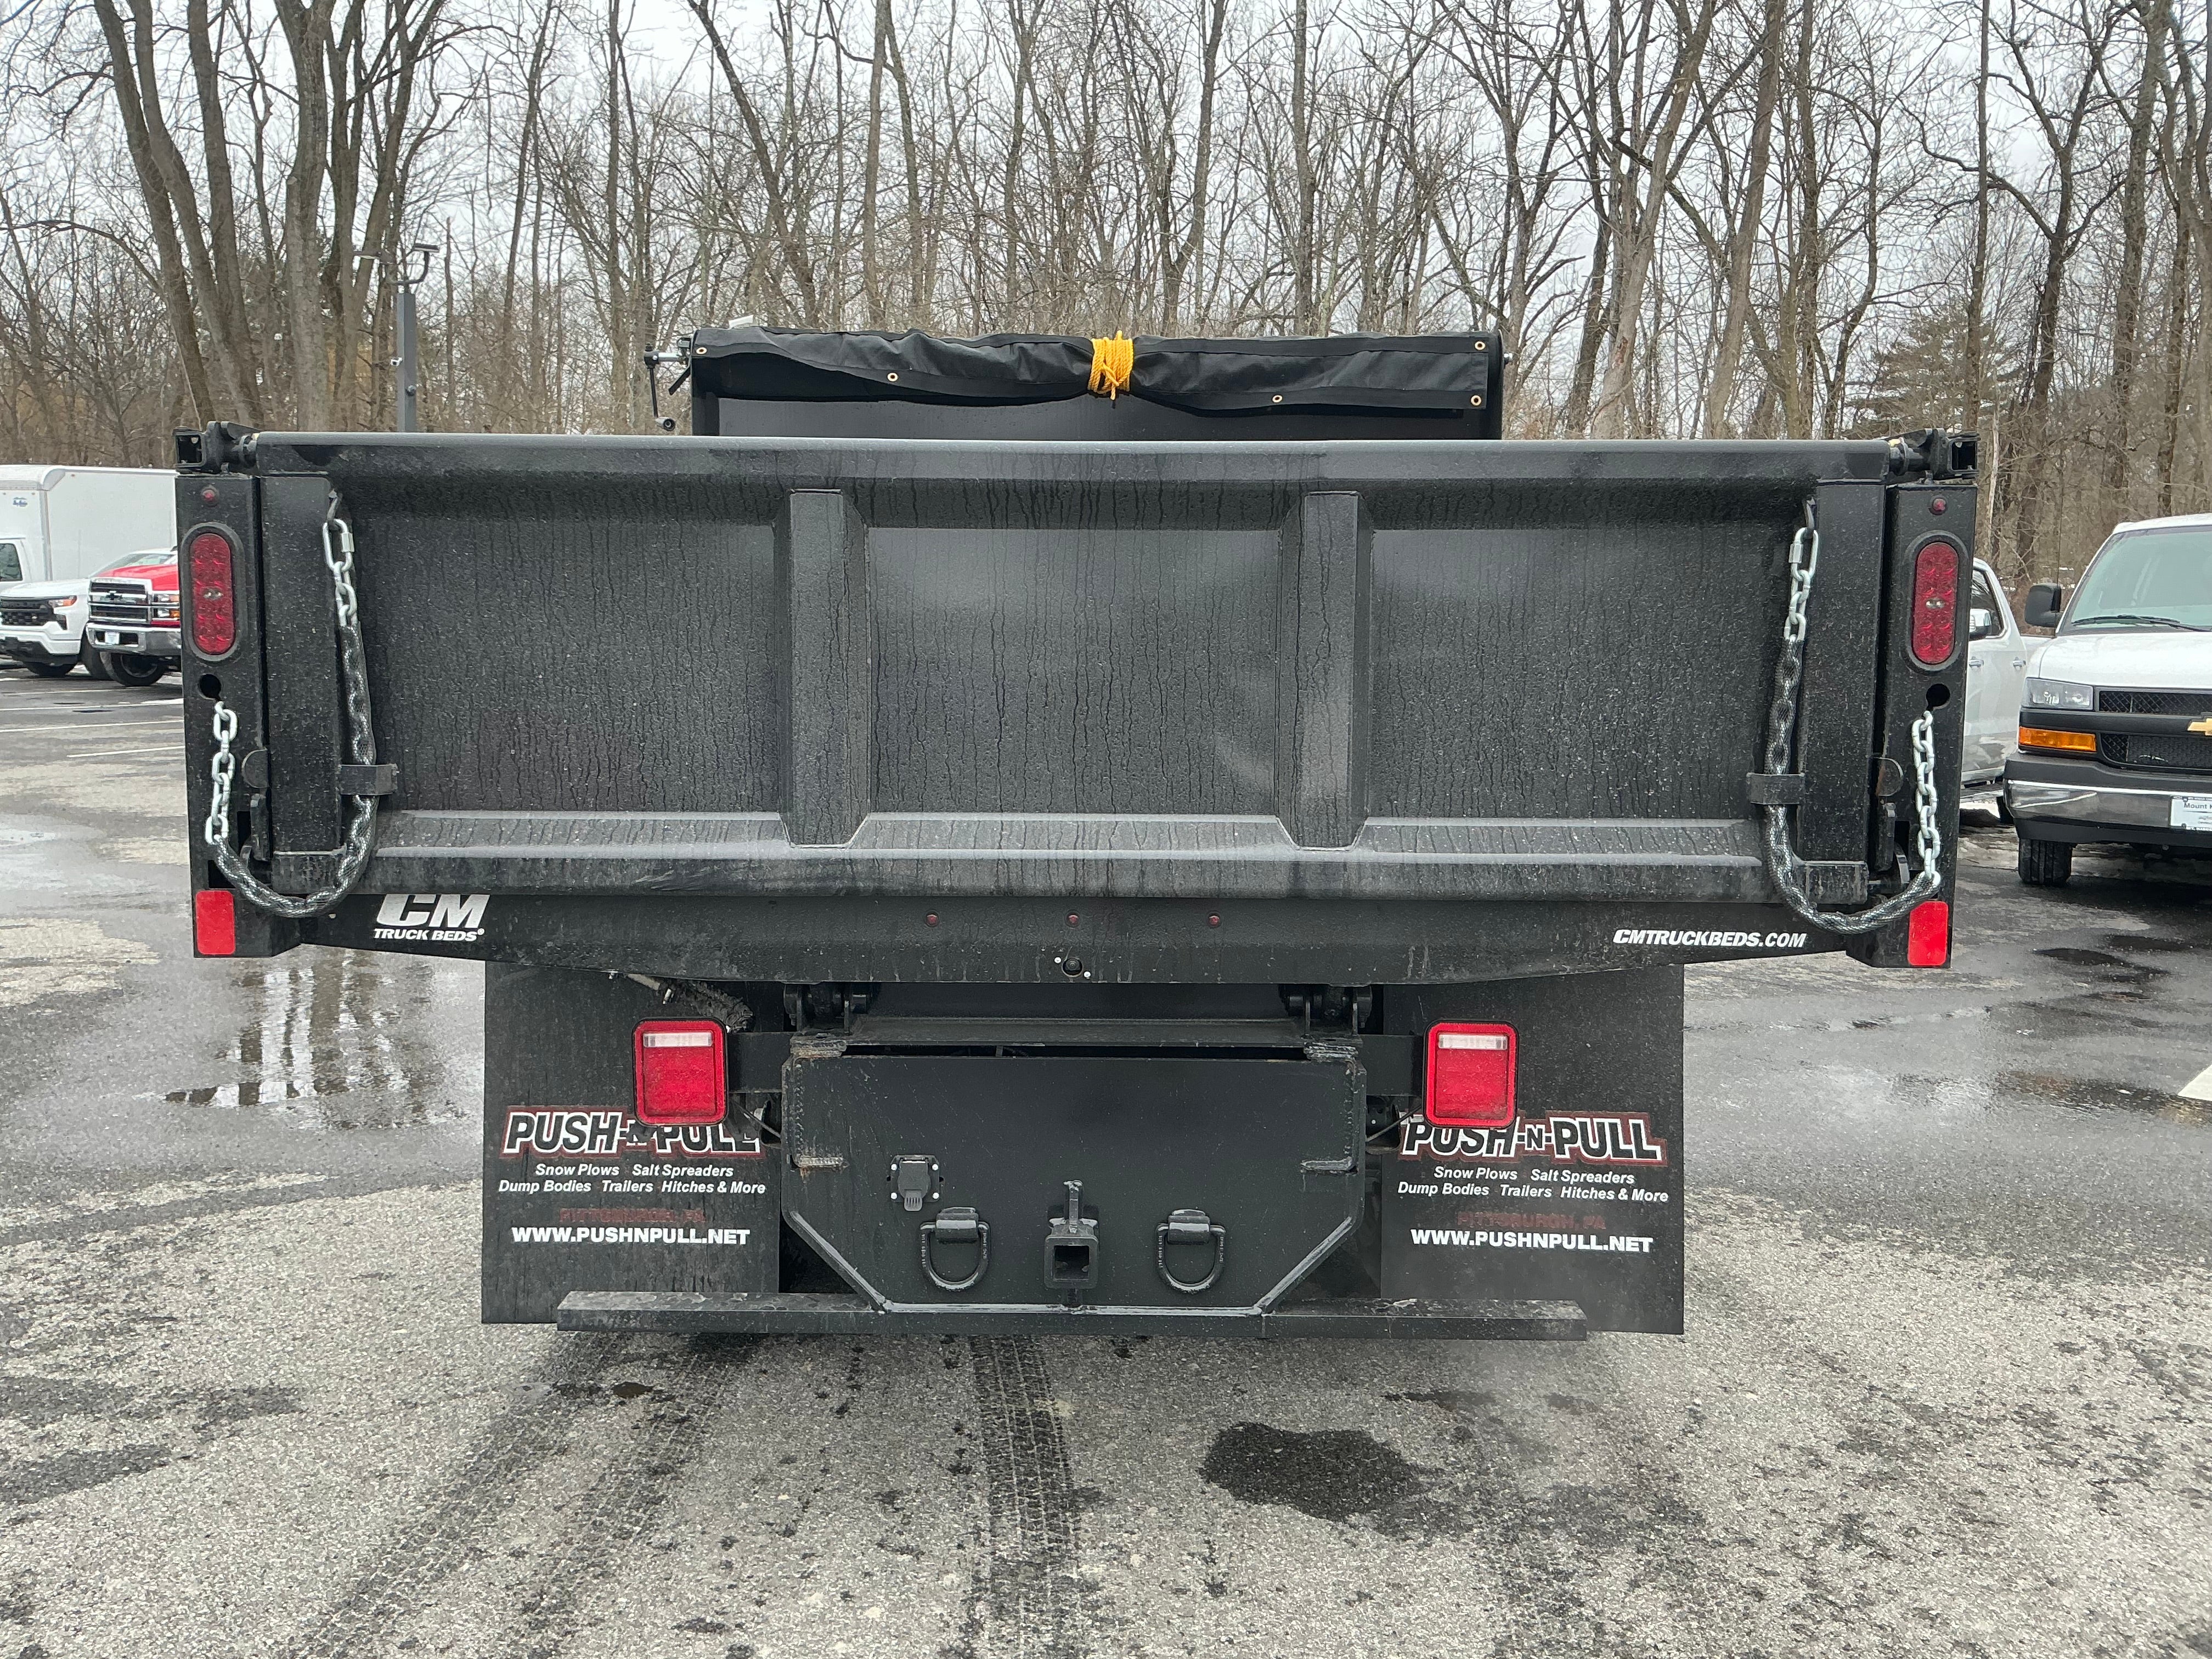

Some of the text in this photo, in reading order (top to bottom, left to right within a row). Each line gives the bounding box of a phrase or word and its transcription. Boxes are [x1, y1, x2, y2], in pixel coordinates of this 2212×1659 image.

[376, 893, 490, 928] CM
[374, 928, 429, 940] TRUCK
[1612, 929, 1807, 947] CMTRUCKBEDS.COM
[535, 1163, 734, 1178] Snow Plows Salt Spreaders
[1434, 1166, 1635, 1185] Snow Plows Salt Spreaders
[498, 1180, 766, 1194] Dump Bodies Trailers Hitches & More
[1397, 1181, 1669, 1203] Dump Bodies Trailers Hitches & More
[511, 1227, 751, 1245] WWW.PUSHNPULL.NET
[1410, 1229, 1654, 1252] WWW.PUSHNPULL.NET
